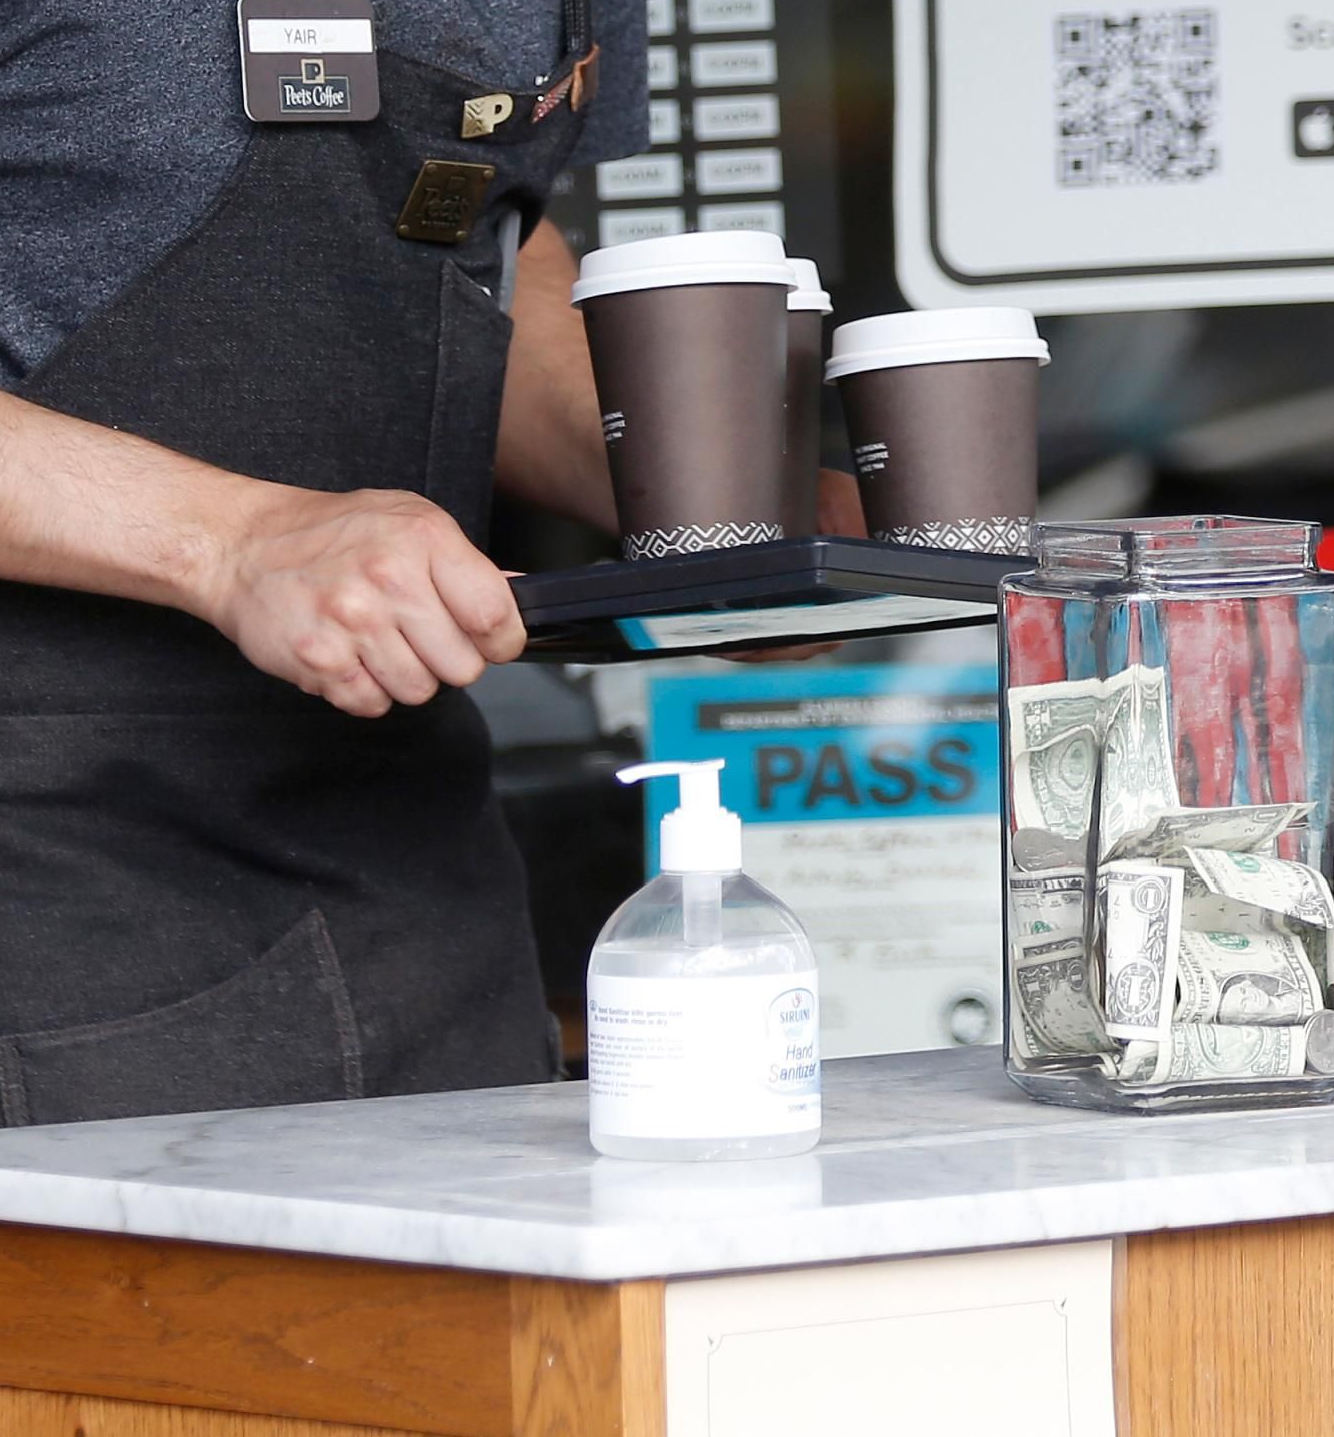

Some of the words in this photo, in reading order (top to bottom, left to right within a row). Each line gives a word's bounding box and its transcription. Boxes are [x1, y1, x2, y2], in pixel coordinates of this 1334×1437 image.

[284, 28, 317, 45] YAIR
[312, 85, 345, 108] Coffee
[755, 737, 976, 811] PASS
[785, 1041, 814, 1061] Hand
